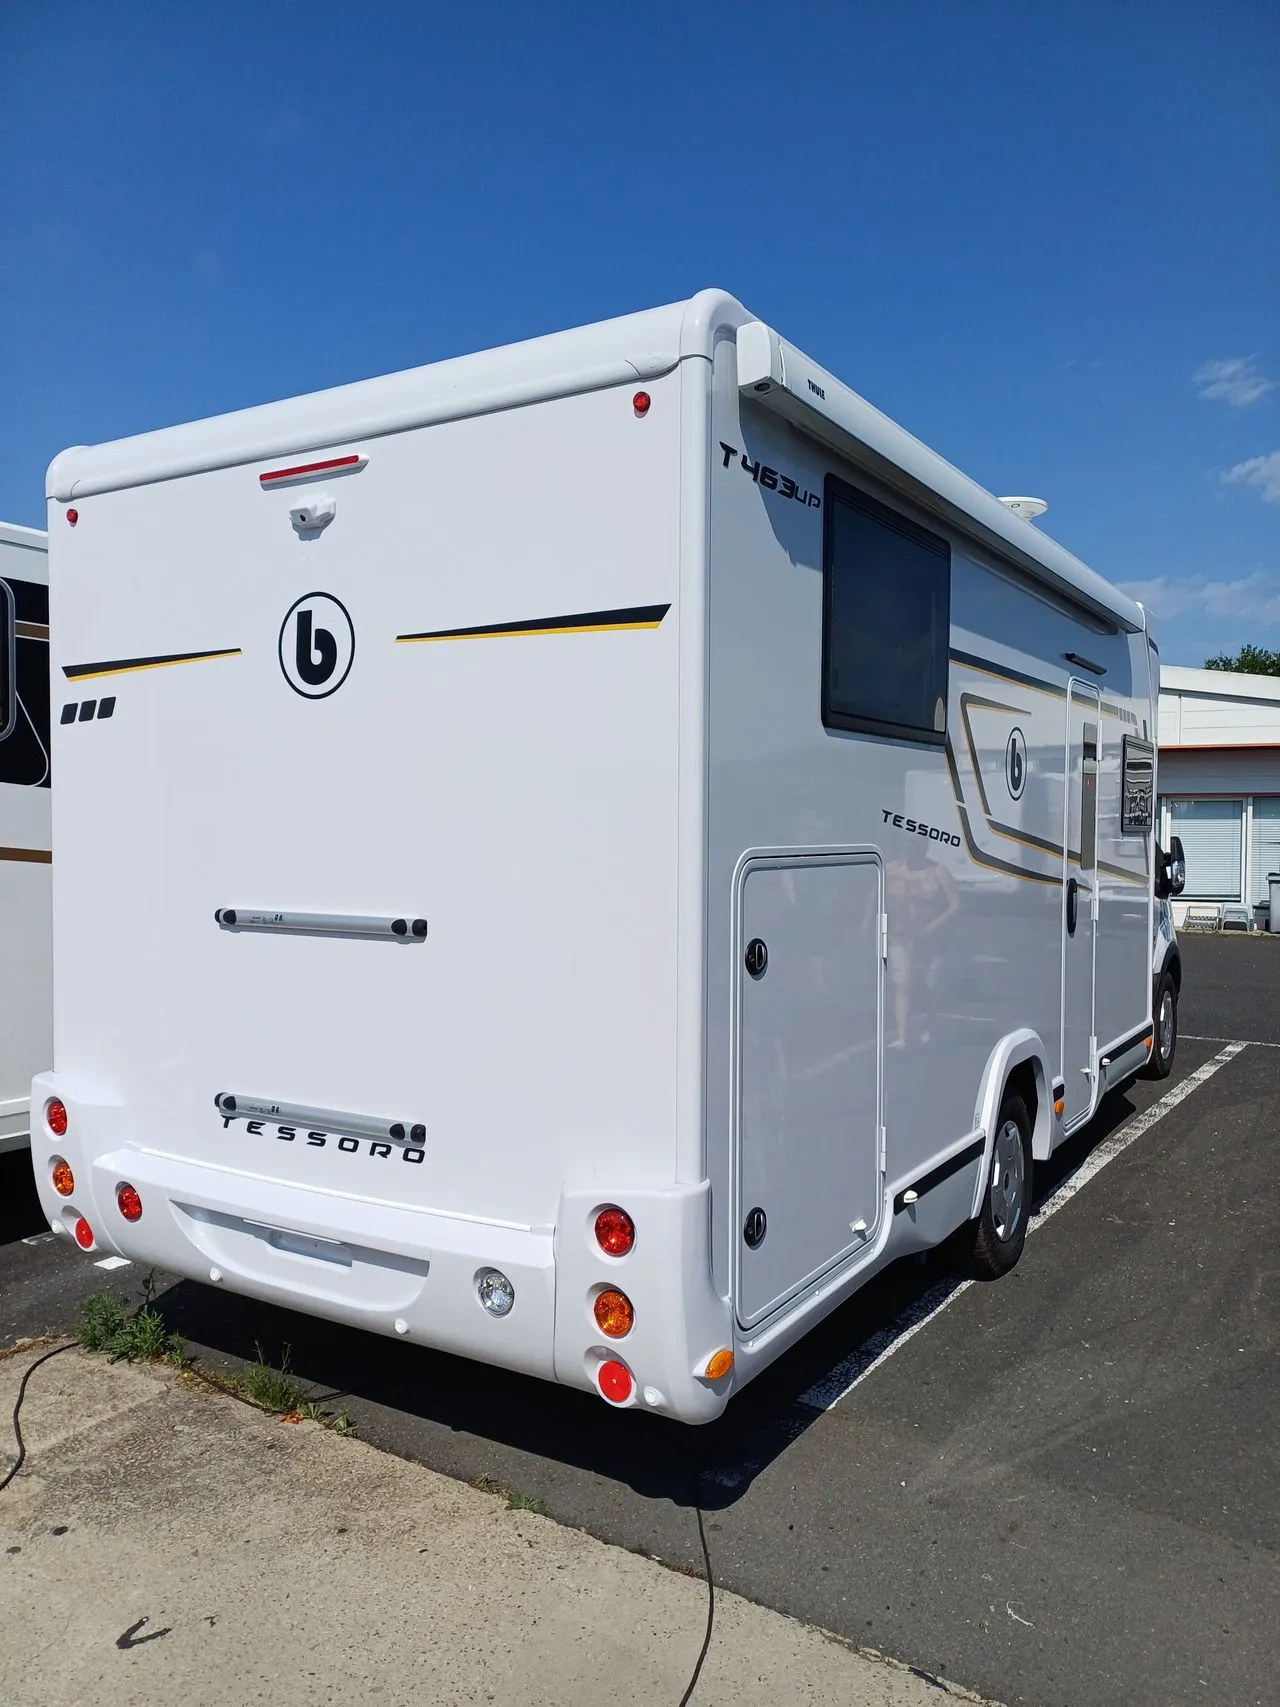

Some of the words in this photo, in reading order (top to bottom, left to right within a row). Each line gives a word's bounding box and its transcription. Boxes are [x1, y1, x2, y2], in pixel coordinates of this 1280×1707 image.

[807, 378, 826, 401] THULE
[882, 809, 961, 848] TESSORO
[220, 1116, 425, 1165] TESSORO
